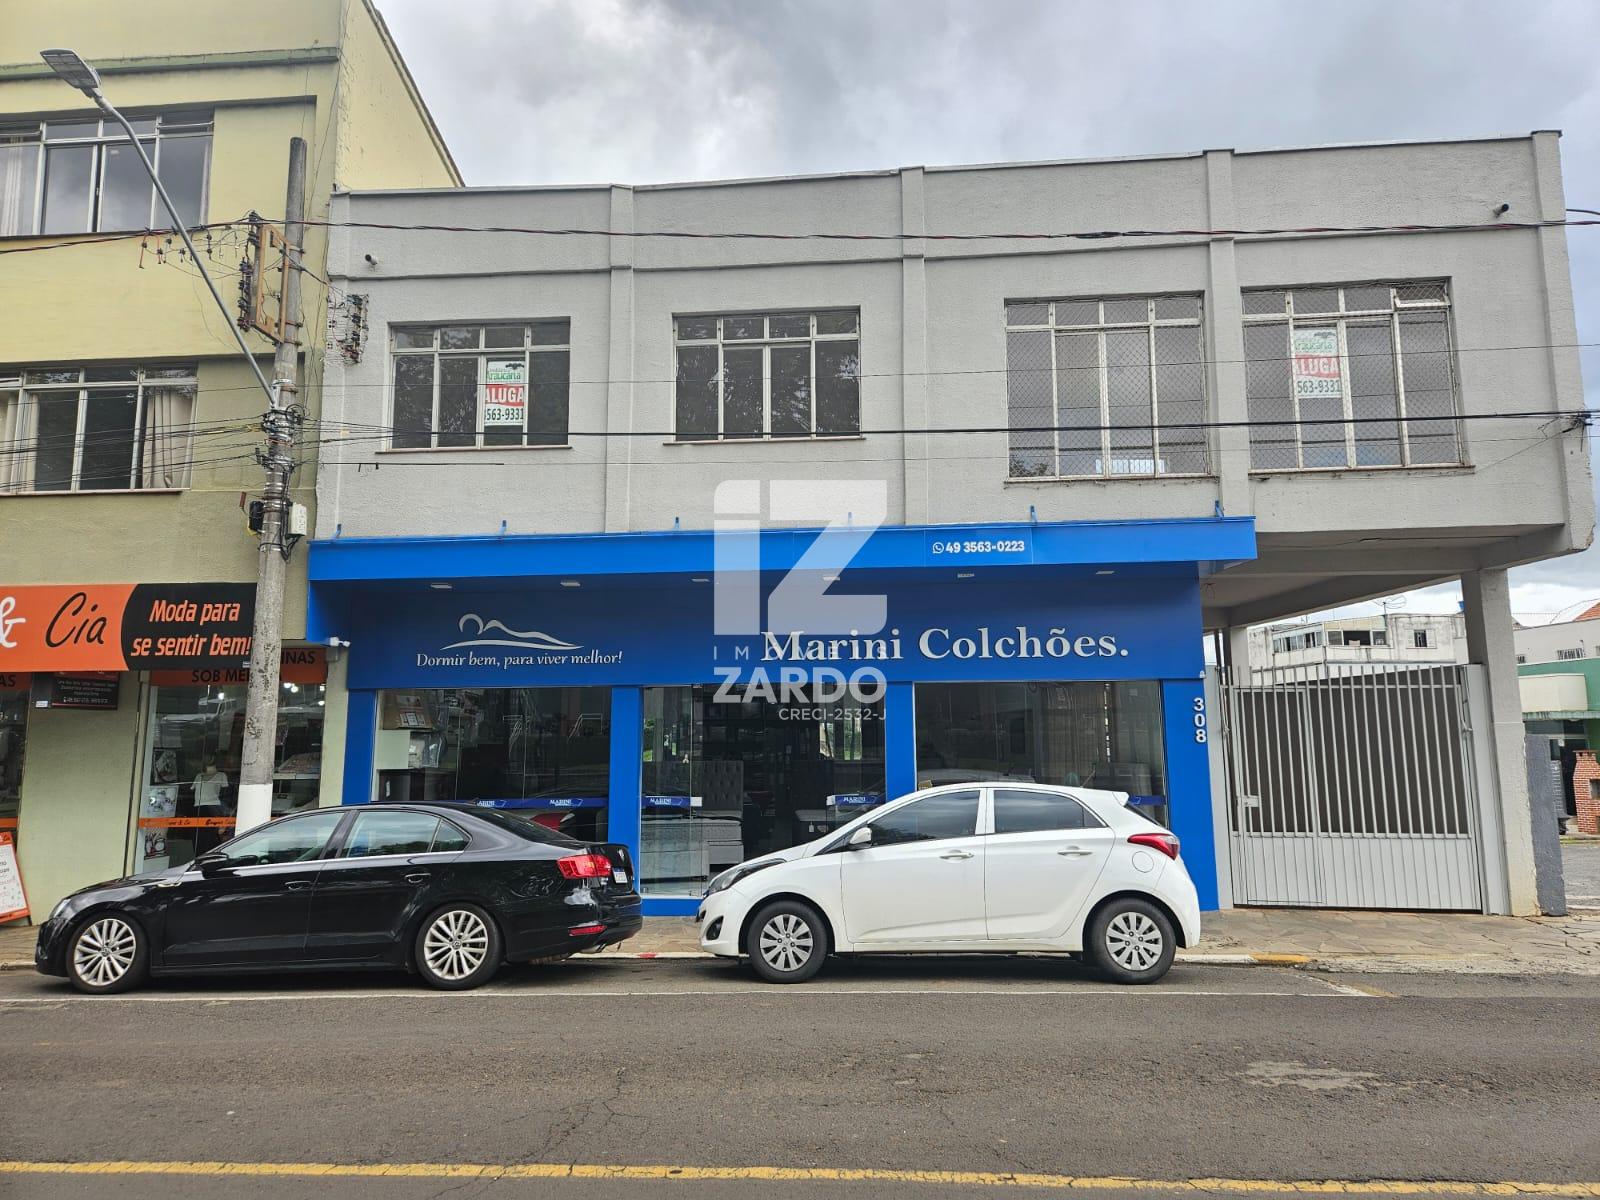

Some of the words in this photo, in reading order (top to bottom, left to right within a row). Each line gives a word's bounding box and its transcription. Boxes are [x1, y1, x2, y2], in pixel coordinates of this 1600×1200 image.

[945, 542, 961, 553] 49
[963, 541, 1025, 553] 3563-0223
[45, 592, 107, 648] Cia
[149, 600, 197, 622] Moda
[200, 602, 241, 625] para
[130, 637, 151, 657] se
[155, 634, 207, 656] sentir
[209, 633, 253, 656] bem!
[761, 628, 903, 662] Marini
[918, 626, 1129, 660] Colchões.
[416, 653, 466, 666] Dormir
[469, 651, 500, 667] bem,
[504, 655, 534, 669] para
[537, 652, 568, 665] viver
[571, 650, 623, 664] melhor!
[192, 670, 221, 682] SOB
[1193, 697, 1207, 743] 308
